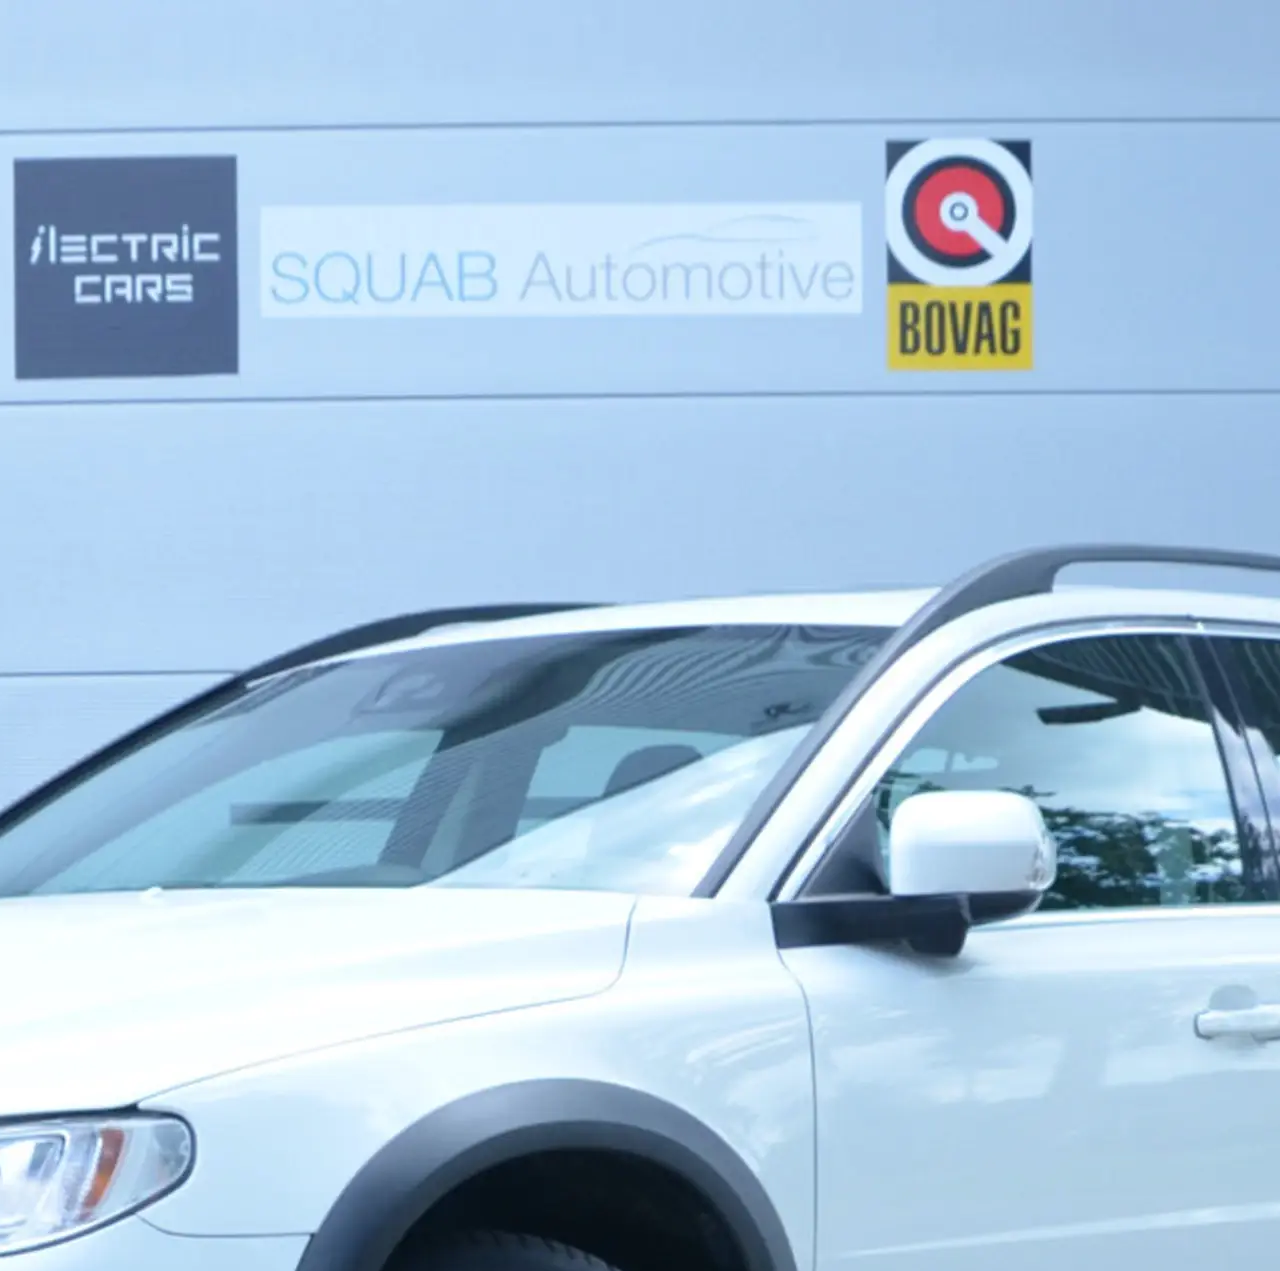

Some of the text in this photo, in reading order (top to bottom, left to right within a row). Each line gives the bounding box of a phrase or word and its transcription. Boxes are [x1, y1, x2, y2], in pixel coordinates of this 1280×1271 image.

[74, 273, 193, 303] CARS
[270, 249, 855, 304] SQUAB Automotive
[898, 299, 1022, 356] BOVAG
